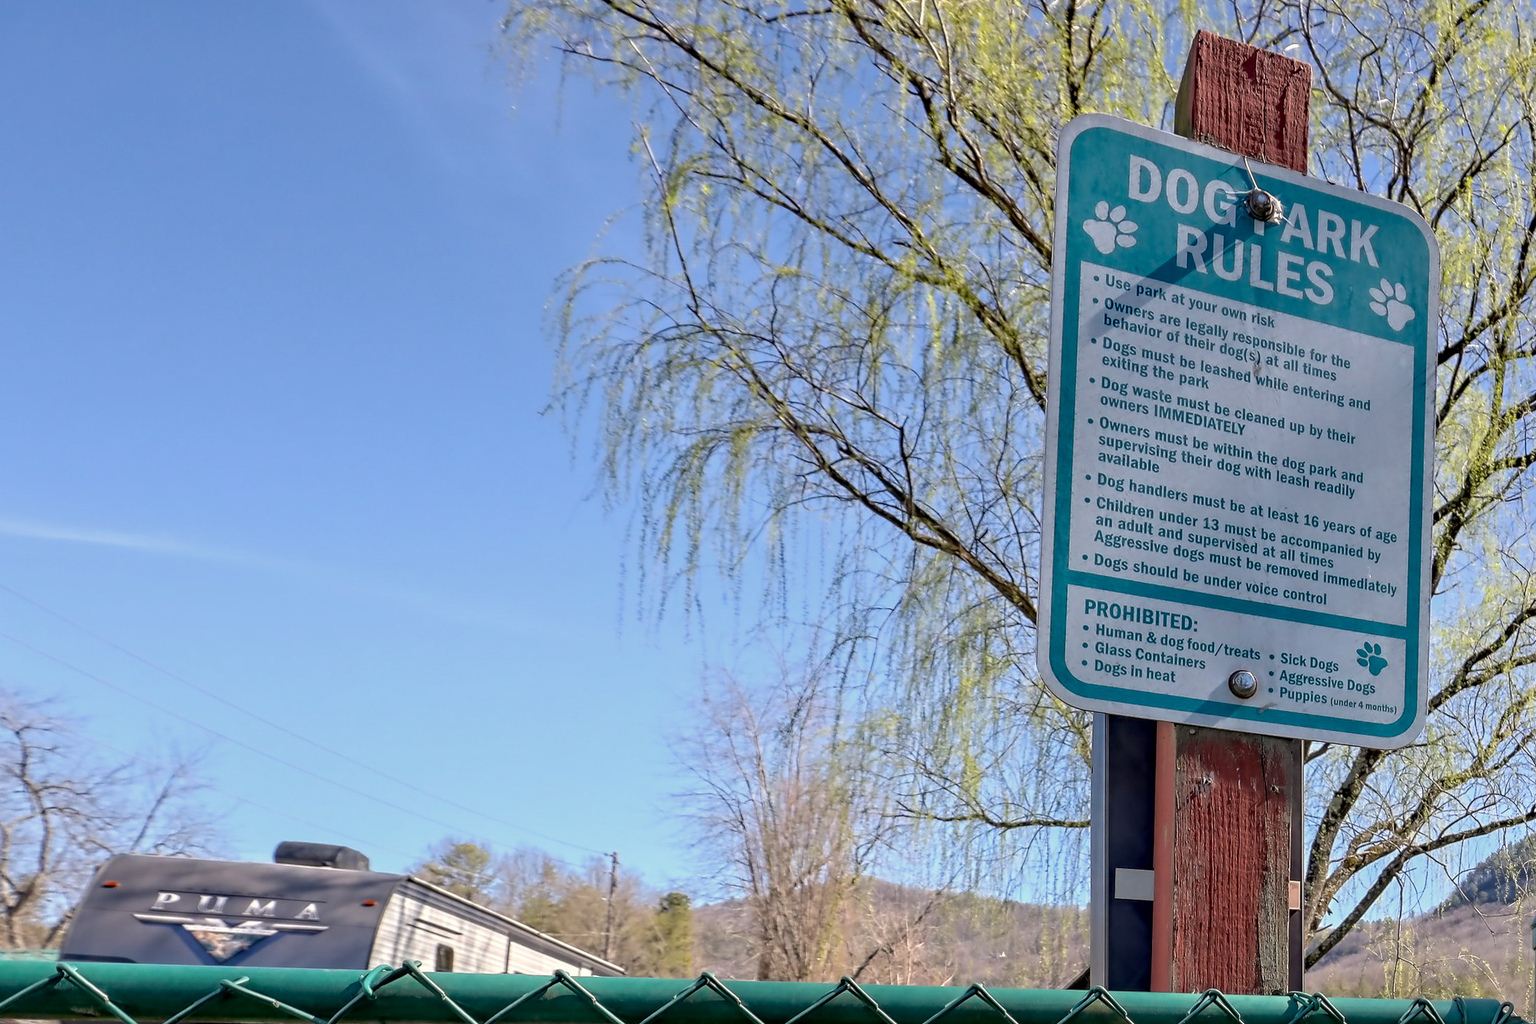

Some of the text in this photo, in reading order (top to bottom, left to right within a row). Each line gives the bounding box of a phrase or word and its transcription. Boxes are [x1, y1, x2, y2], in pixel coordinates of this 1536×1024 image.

[1128, 154, 1237, 228] DOG
[1176, 223, 1335, 306] RULES
[1105, 274, 1275, 328] Use park at your own risk
[1105, 298, 1350, 369] Owners are legally responsible for the
[1105, 315, 1336, 381] behavior of their dog(s) at all times
[1102, 356, 1209, 389] exiting the park
[1103, 337, 1370, 411] Dogs must be leashed while entering and
[1100, 396, 1245, 435] owners IMMEDIATELY
[1102, 376, 1356, 444] Dog waste must be cleaned up by their
[1098, 453, 1159, 473] available
[1099, 436, 1355, 499] supervising their dog with leash readily
[1100, 417, 1363, 483] Owners must be within the dog park and
[1097, 497, 1380, 564] Children under 13 must be accompanied by
[1098, 472, 1397, 544] Dog handlers must be at least 16 years of age
[1094, 530, 1397, 597] Aggressive dogs must be removed immediately
[1096, 516, 1334, 568] an adult and supervised at all times
[1094, 553, 1326, 605] Dogs should be under voice control
[1085, 599, 1197, 630] PROHIBITED:
[1095, 642, 1205, 669] Glass Containers
[1096, 623, 1260, 660] Human & dog food/treats
[1281, 653, 1338, 673] Sick Dogs
[1095, 659, 1176, 683] Dogs in heat
[1279, 670, 1375, 696] Aggressive Dogs
[1280, 687, 1327, 704] Puppies
[1331, 697, 1356, 708] (under
[1366, 704, 1397, 715] months)
[151, 892, 320, 920] PUMA
